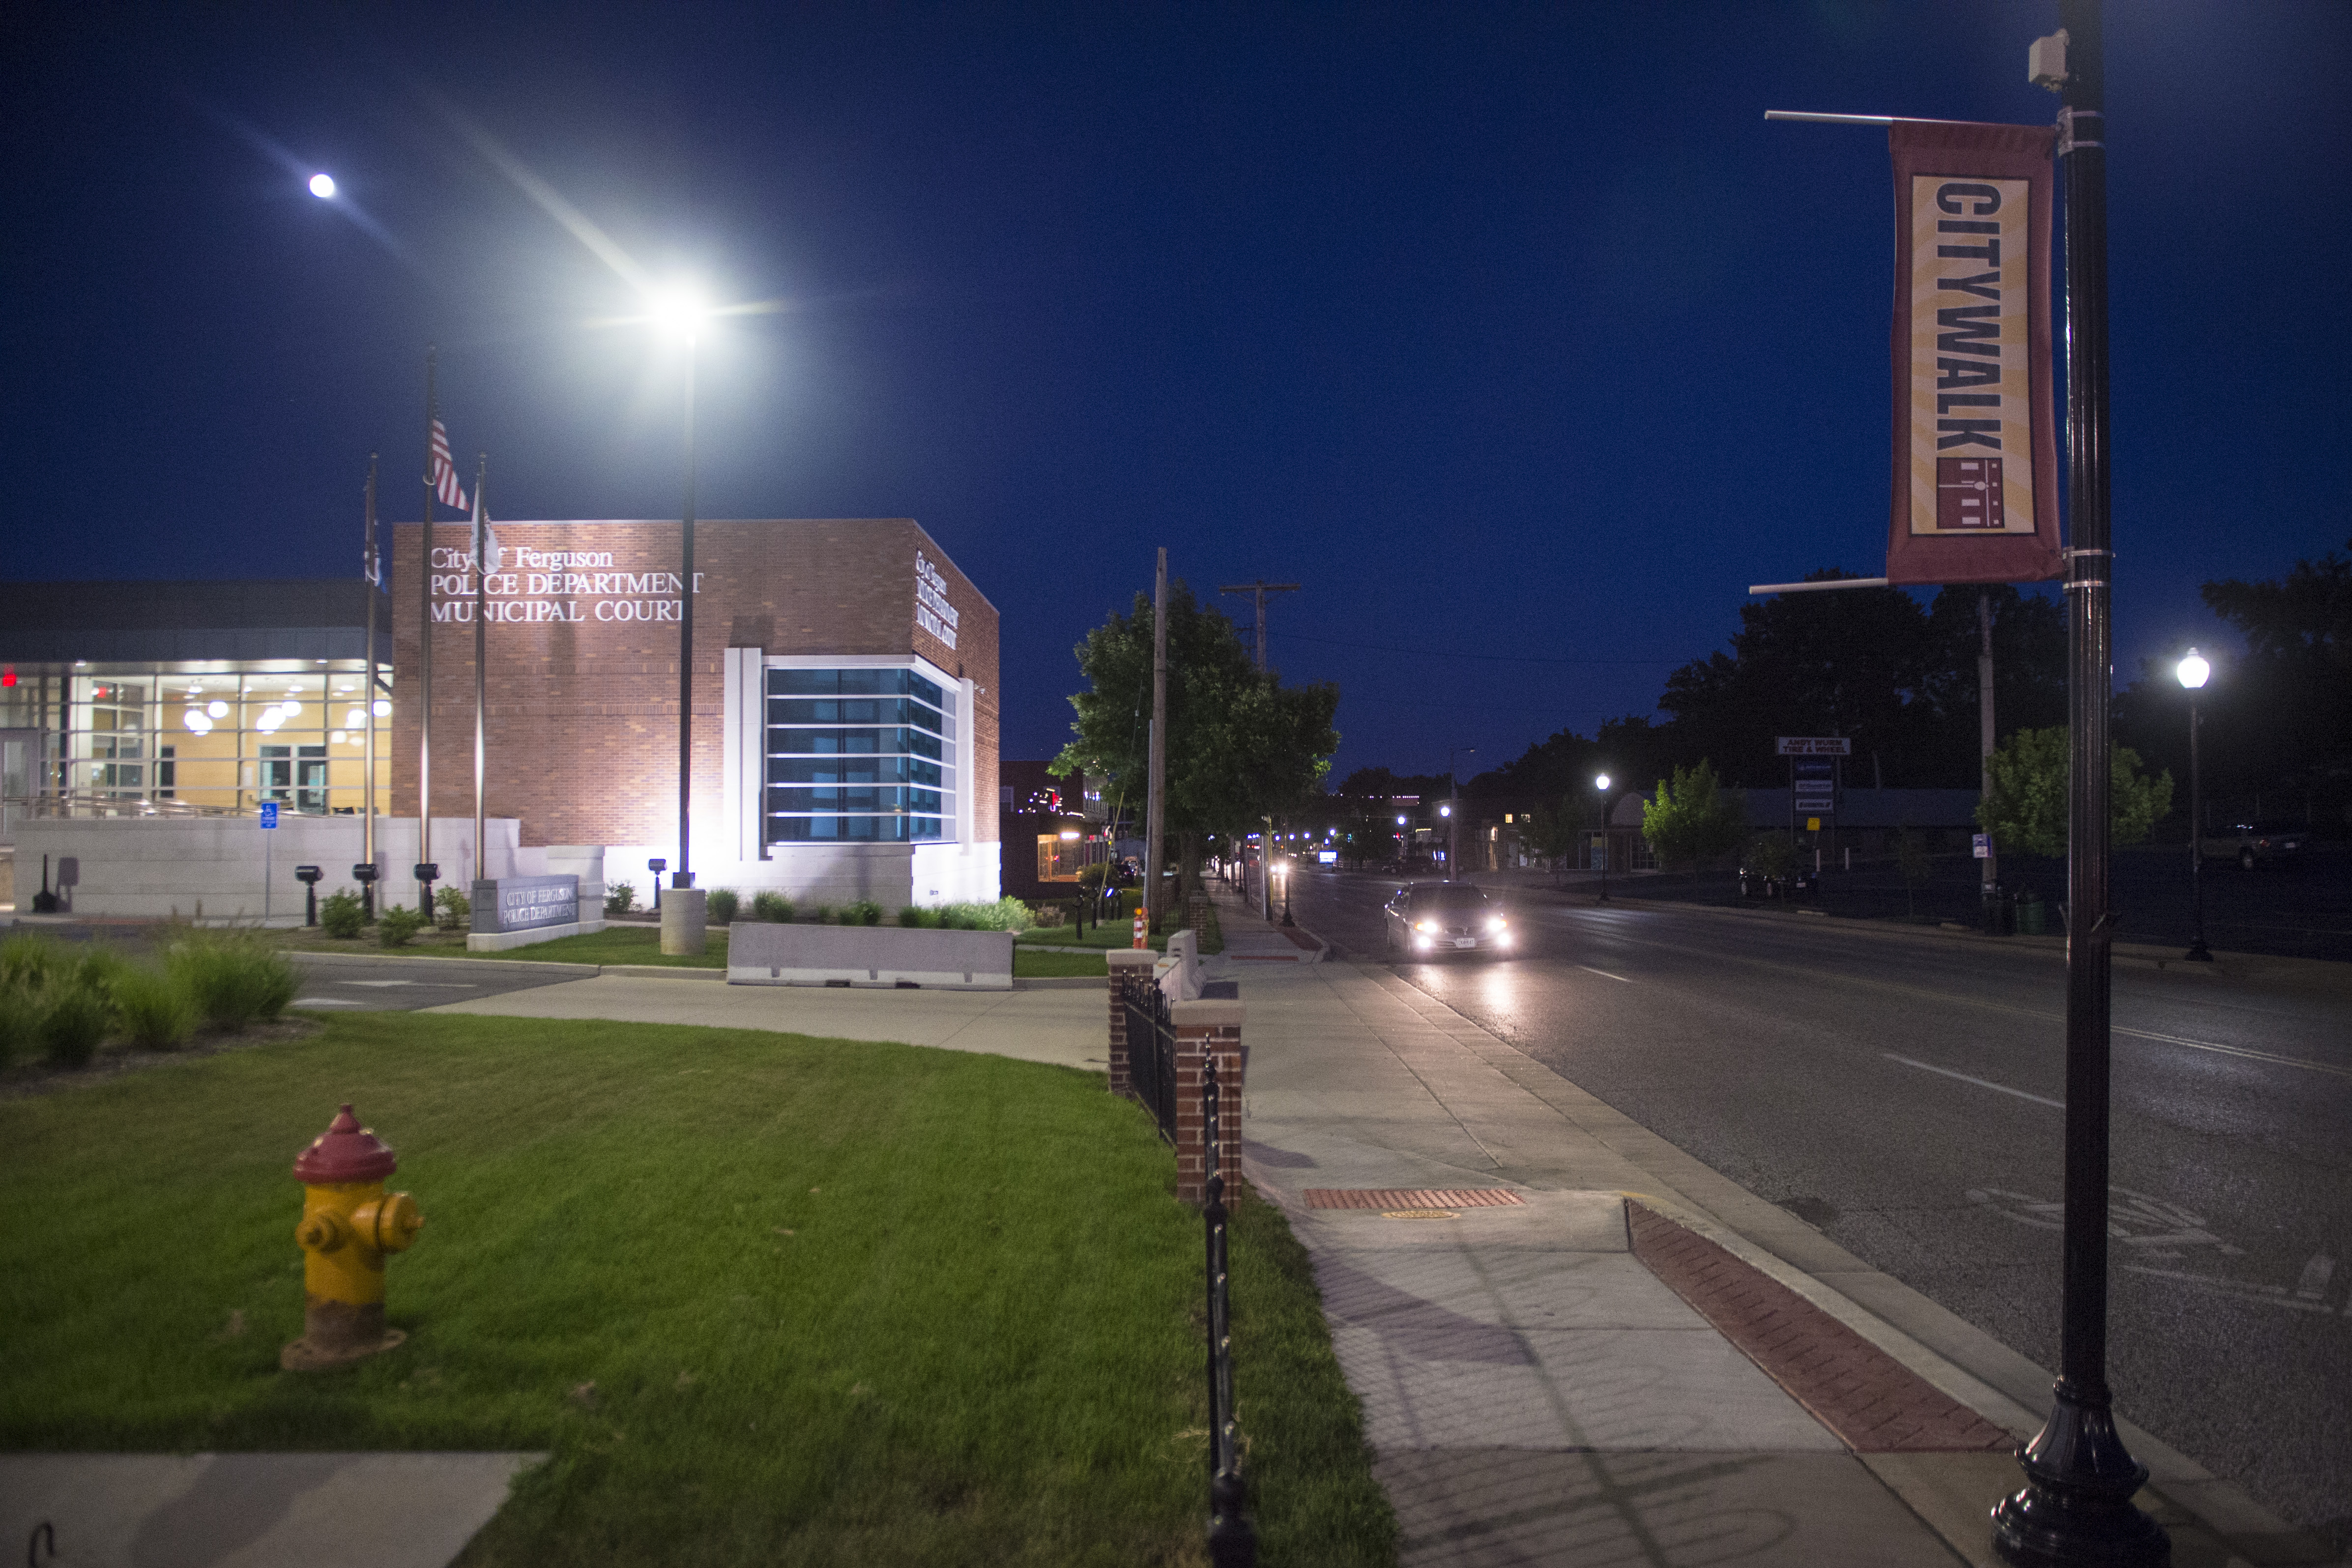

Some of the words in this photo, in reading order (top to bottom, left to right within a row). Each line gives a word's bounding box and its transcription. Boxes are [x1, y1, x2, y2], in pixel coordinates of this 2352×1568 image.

[1937, 183, 2002, 451] CITYWALK
[431, 547, 470, 572] City
[515, 546, 614, 572] Ferguson
[431, 574, 520, 595] POLCE
[526, 573, 704, 595] DEPARTMENT
[431, 601, 585, 622] MUNICIPAL
[595, 600, 683, 621] COURT
[507, 892, 525, 906] CITY
[527, 891, 536, 904] OF
[538, 888, 572, 902] FERGUSON
[503, 908, 528, 924] POLICE
[530, 903, 576, 920] DEPARTMENT
